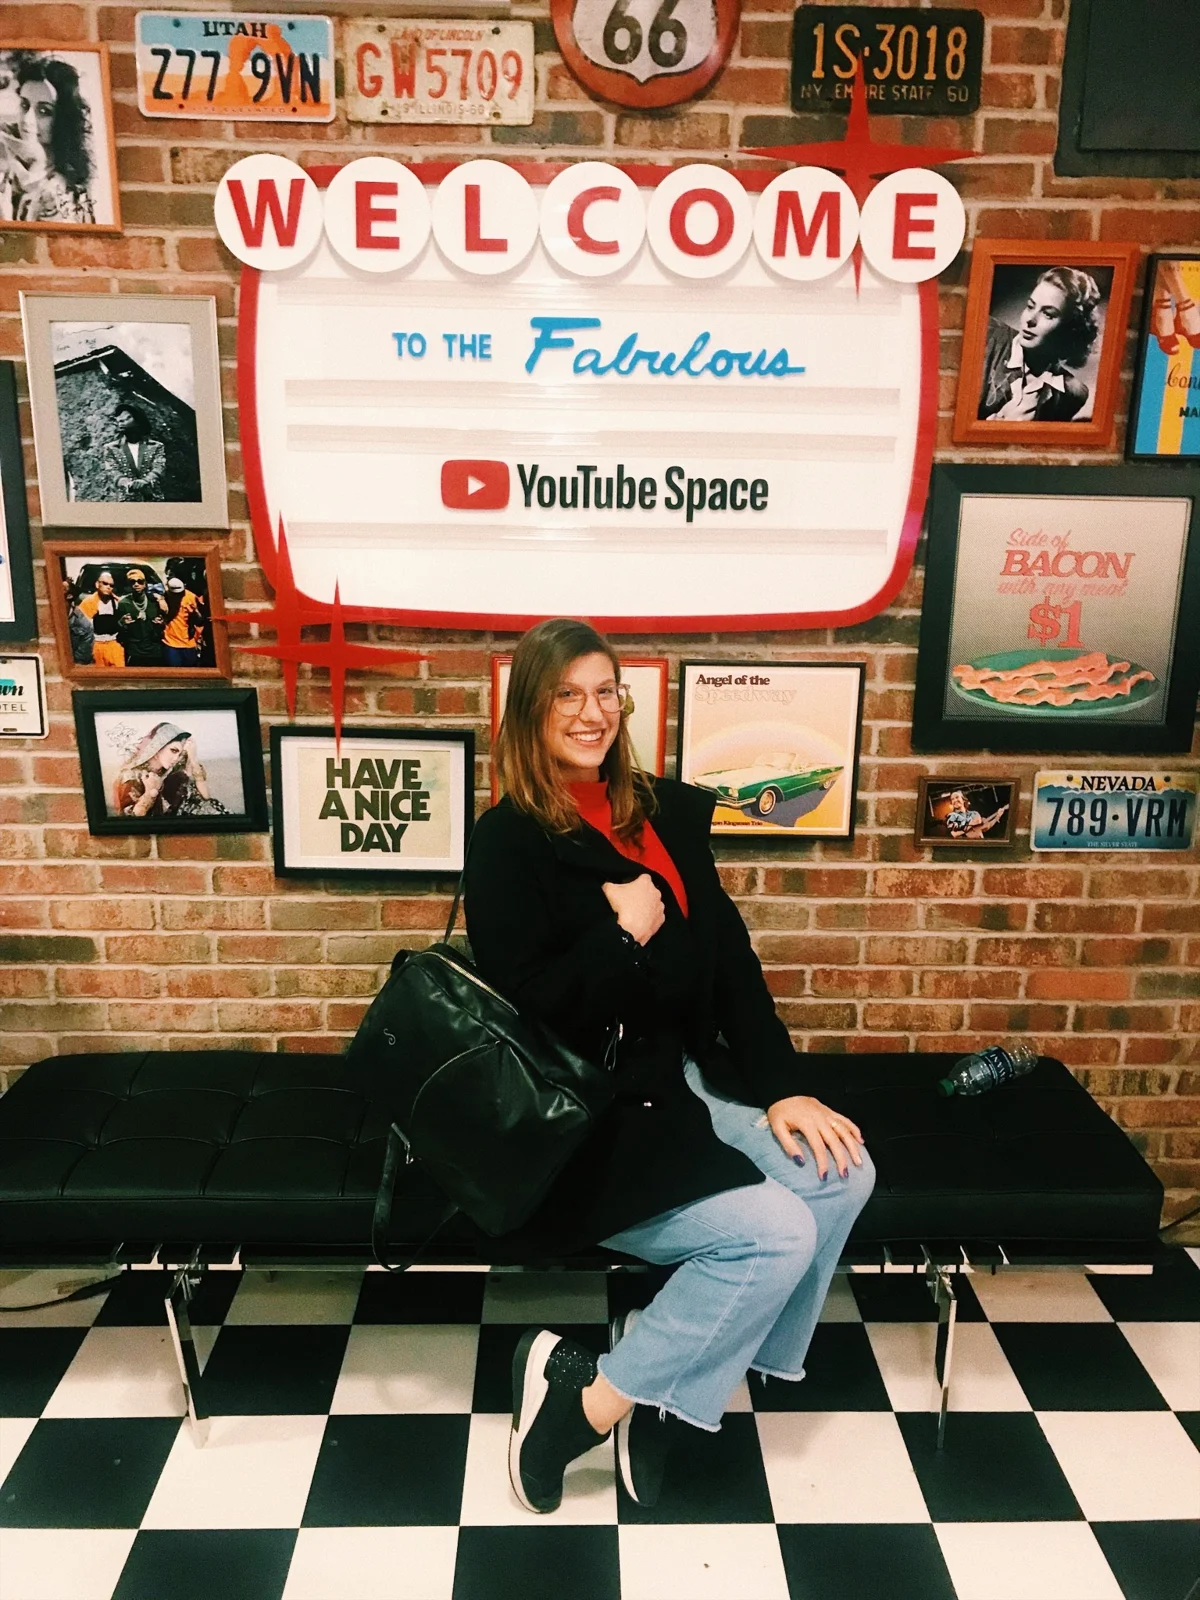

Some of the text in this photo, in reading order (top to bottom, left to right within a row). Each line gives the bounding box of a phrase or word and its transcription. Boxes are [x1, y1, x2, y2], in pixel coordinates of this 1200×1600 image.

[202, 21, 268, 39] UTAH
[440, 28, 484, 41] LINCOLN
[603, 0, 688, 68] 66
[251, 51, 321, 104] 9VN
[836, 83, 886, 100] EMIRE
[892, 85, 934, 101] STATE
[227, 178, 938, 261] WELCOME
[392, 316, 806, 378] TO THE Fabulous
[517, 464, 769, 523] YouTube Space
[1007, 527, 1072, 552] Side of
[1000, 549, 1136, 579] BACON
[997, 577, 1036, 595] with
[1027, 595, 1085, 649] $1
[695, 674, 770, 688] Angel of the
[695, 685, 798, 706] Speedway
[0, 703, 27, 712] TEL
[326, 757, 423, 791] HAVE
[1080, 775, 1157, 792] NEVADA
[318, 789, 431, 821] A NICE
[340, 822, 409, 853] DAY
